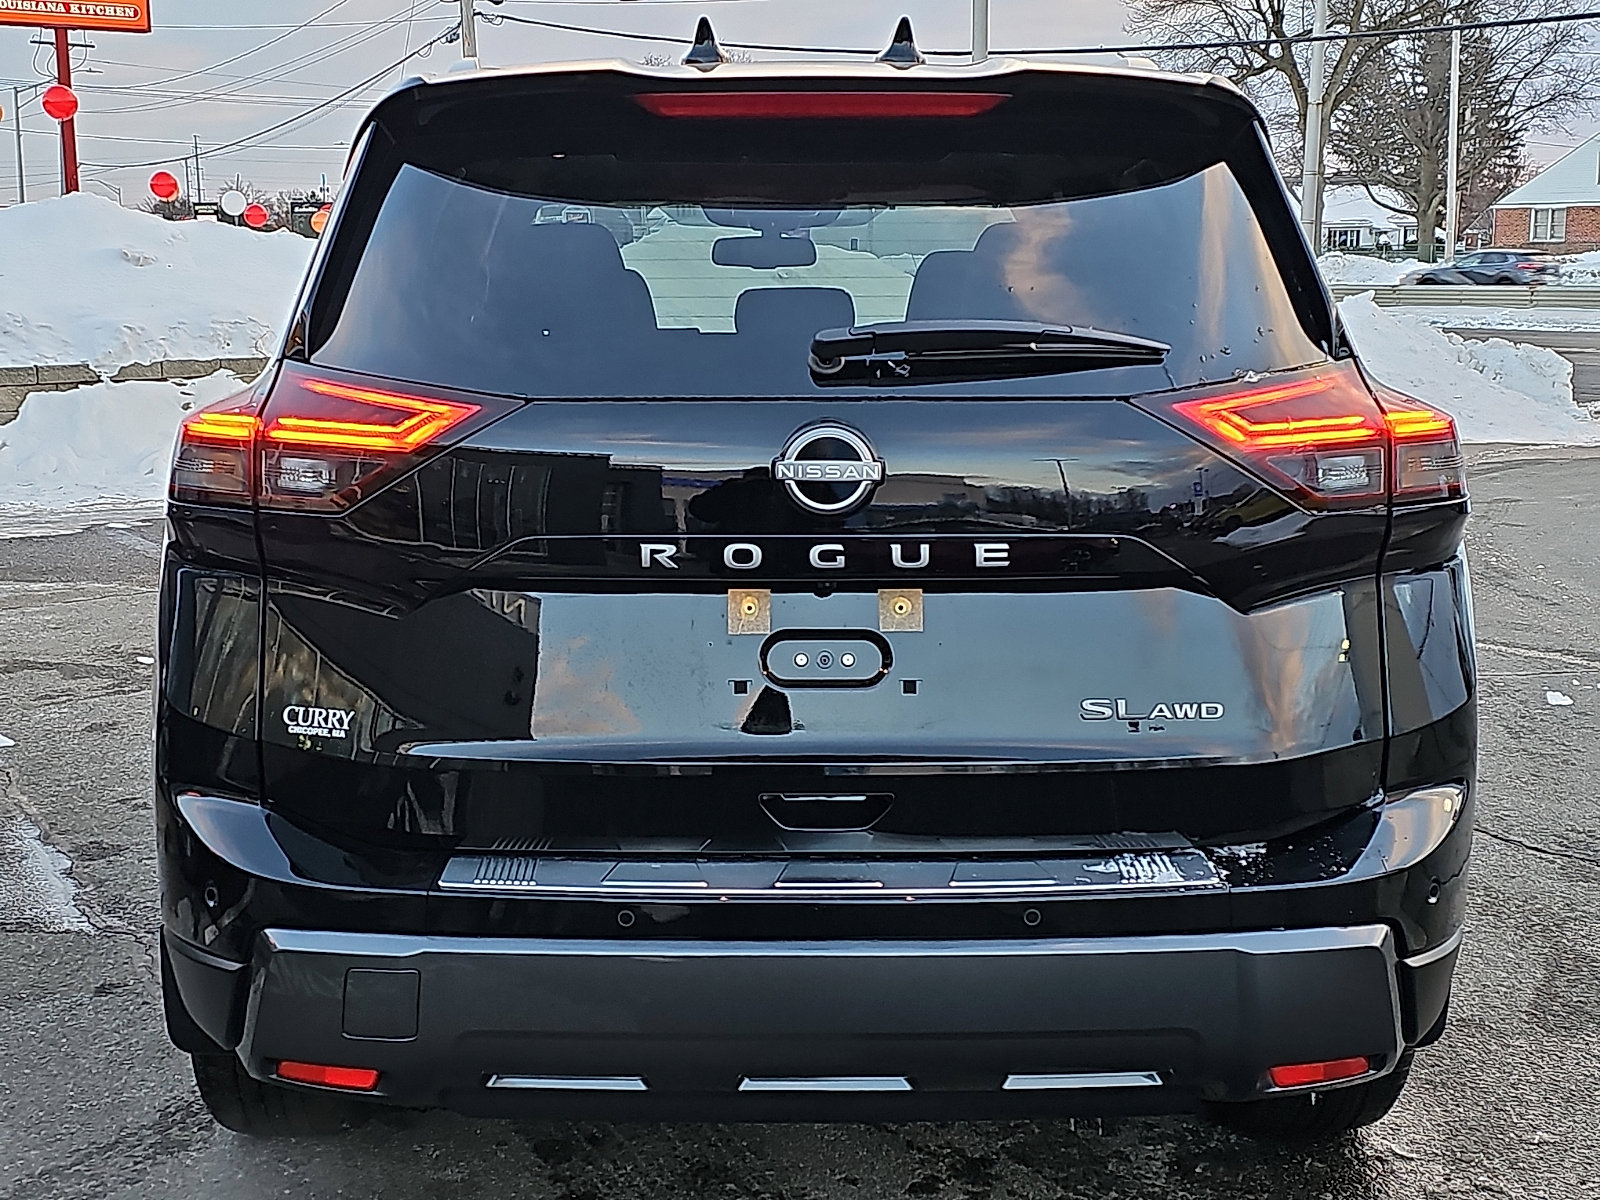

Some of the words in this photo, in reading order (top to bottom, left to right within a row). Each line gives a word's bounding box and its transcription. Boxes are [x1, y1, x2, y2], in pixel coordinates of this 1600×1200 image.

[69, 3, 135, 18] KITCHEN
[778, 464, 880, 479] NISSAN
[640, 543, 1011, 569] ROGUE
[282, 705, 356, 730] CURRY
[1081, 699, 1147, 720] SL
[1149, 703, 1224, 719] AWD
